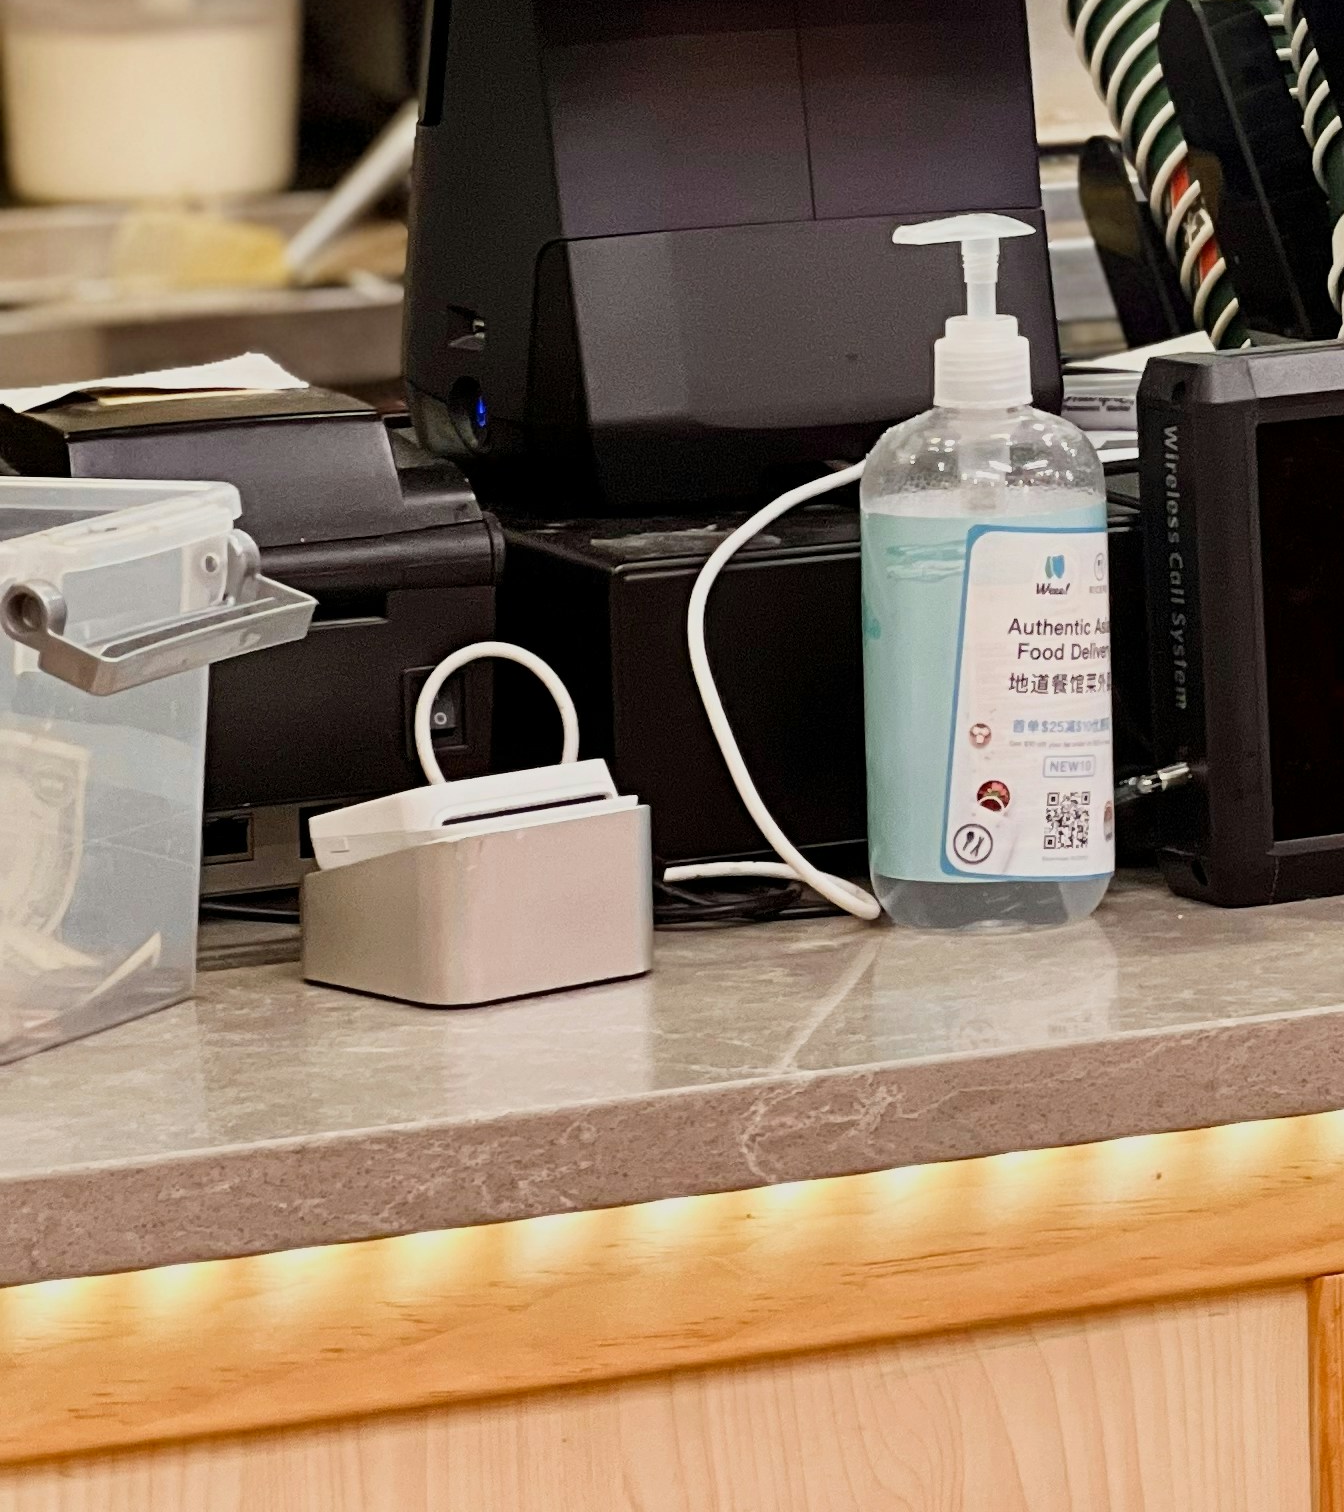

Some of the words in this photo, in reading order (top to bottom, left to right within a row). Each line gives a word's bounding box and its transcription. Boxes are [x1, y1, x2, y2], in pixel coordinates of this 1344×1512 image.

[1163, 425, 1181, 544] Wireless
[1169, 552, 1186, 605] Call
[1008, 618, 1091, 636] Authentic
[1017, 643, 1065, 660] Food
[1170, 612, 1188, 710] System
